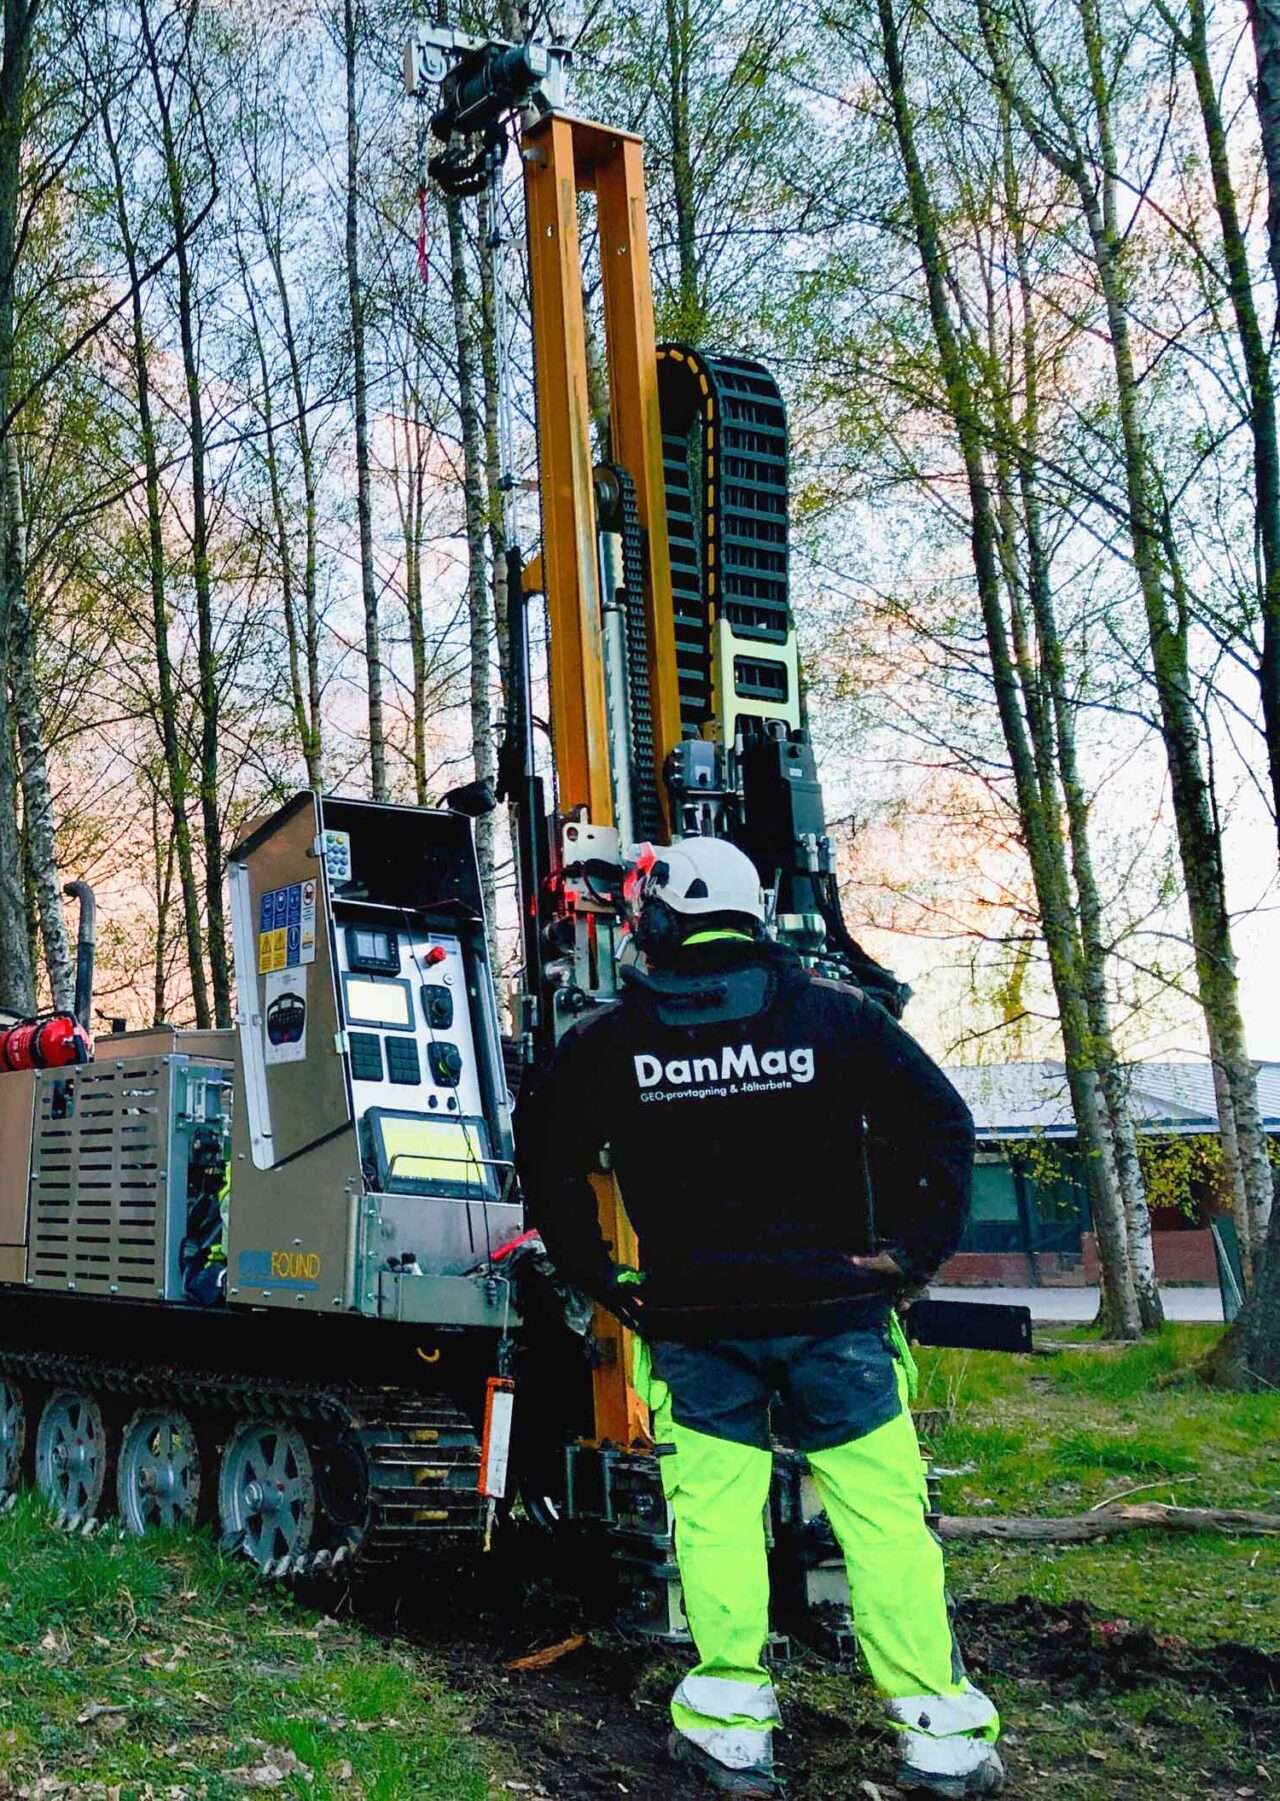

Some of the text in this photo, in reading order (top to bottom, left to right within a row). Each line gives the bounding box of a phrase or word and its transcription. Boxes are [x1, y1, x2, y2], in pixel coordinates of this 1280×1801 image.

[634, 1044, 815, 1087] DanMag
[640, 1086, 727, 1102] GEO-provtagning
[730, 1084, 738, 1093] &
